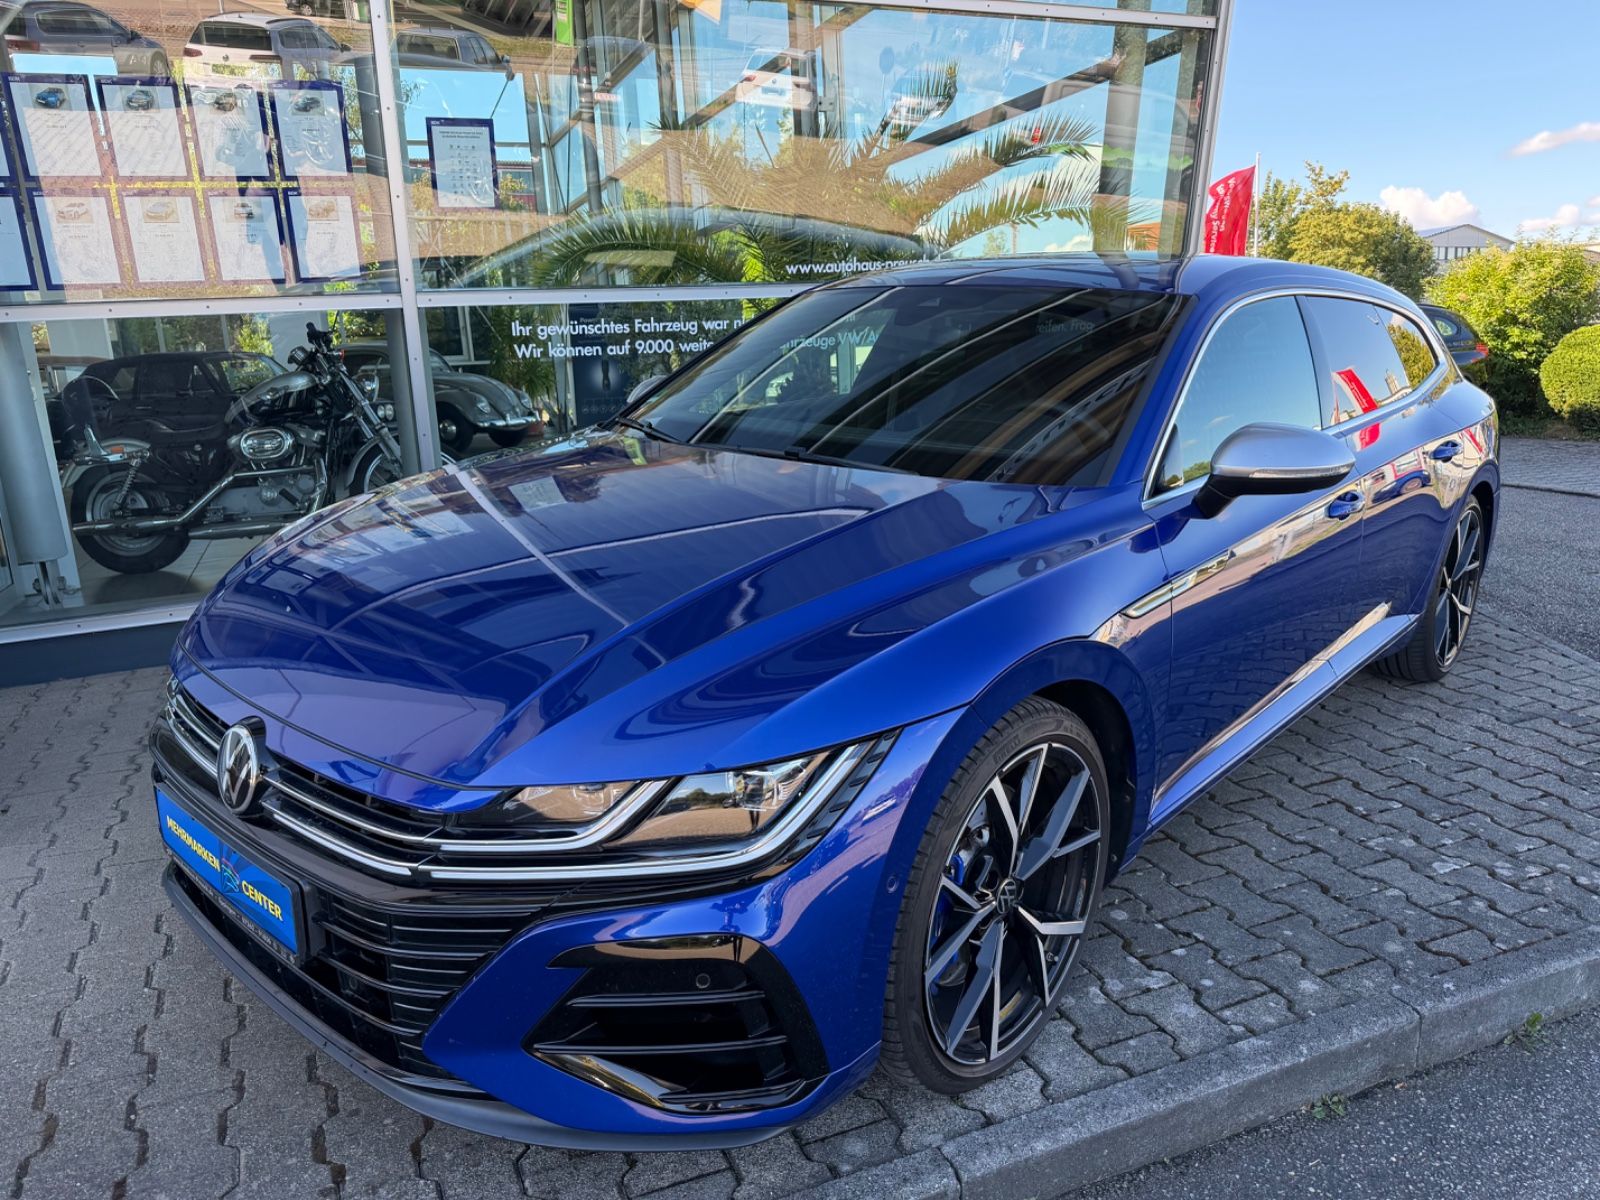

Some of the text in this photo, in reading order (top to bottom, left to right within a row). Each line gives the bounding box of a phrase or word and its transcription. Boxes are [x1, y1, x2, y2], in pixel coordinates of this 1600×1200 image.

[511, 321, 532, 337] Ihr
[538, 317, 630, 340] gewünschtes
[634, 315, 698, 335] Fahrzeug
[703, 318, 729, 330] war
[514, 342, 543, 358] Wir
[548, 340, 602, 357] können
[607, 339, 630, 355] auf
[166, 815, 221, 873] MEHRMARKEN
[241, 880, 283, 922] CENTER
